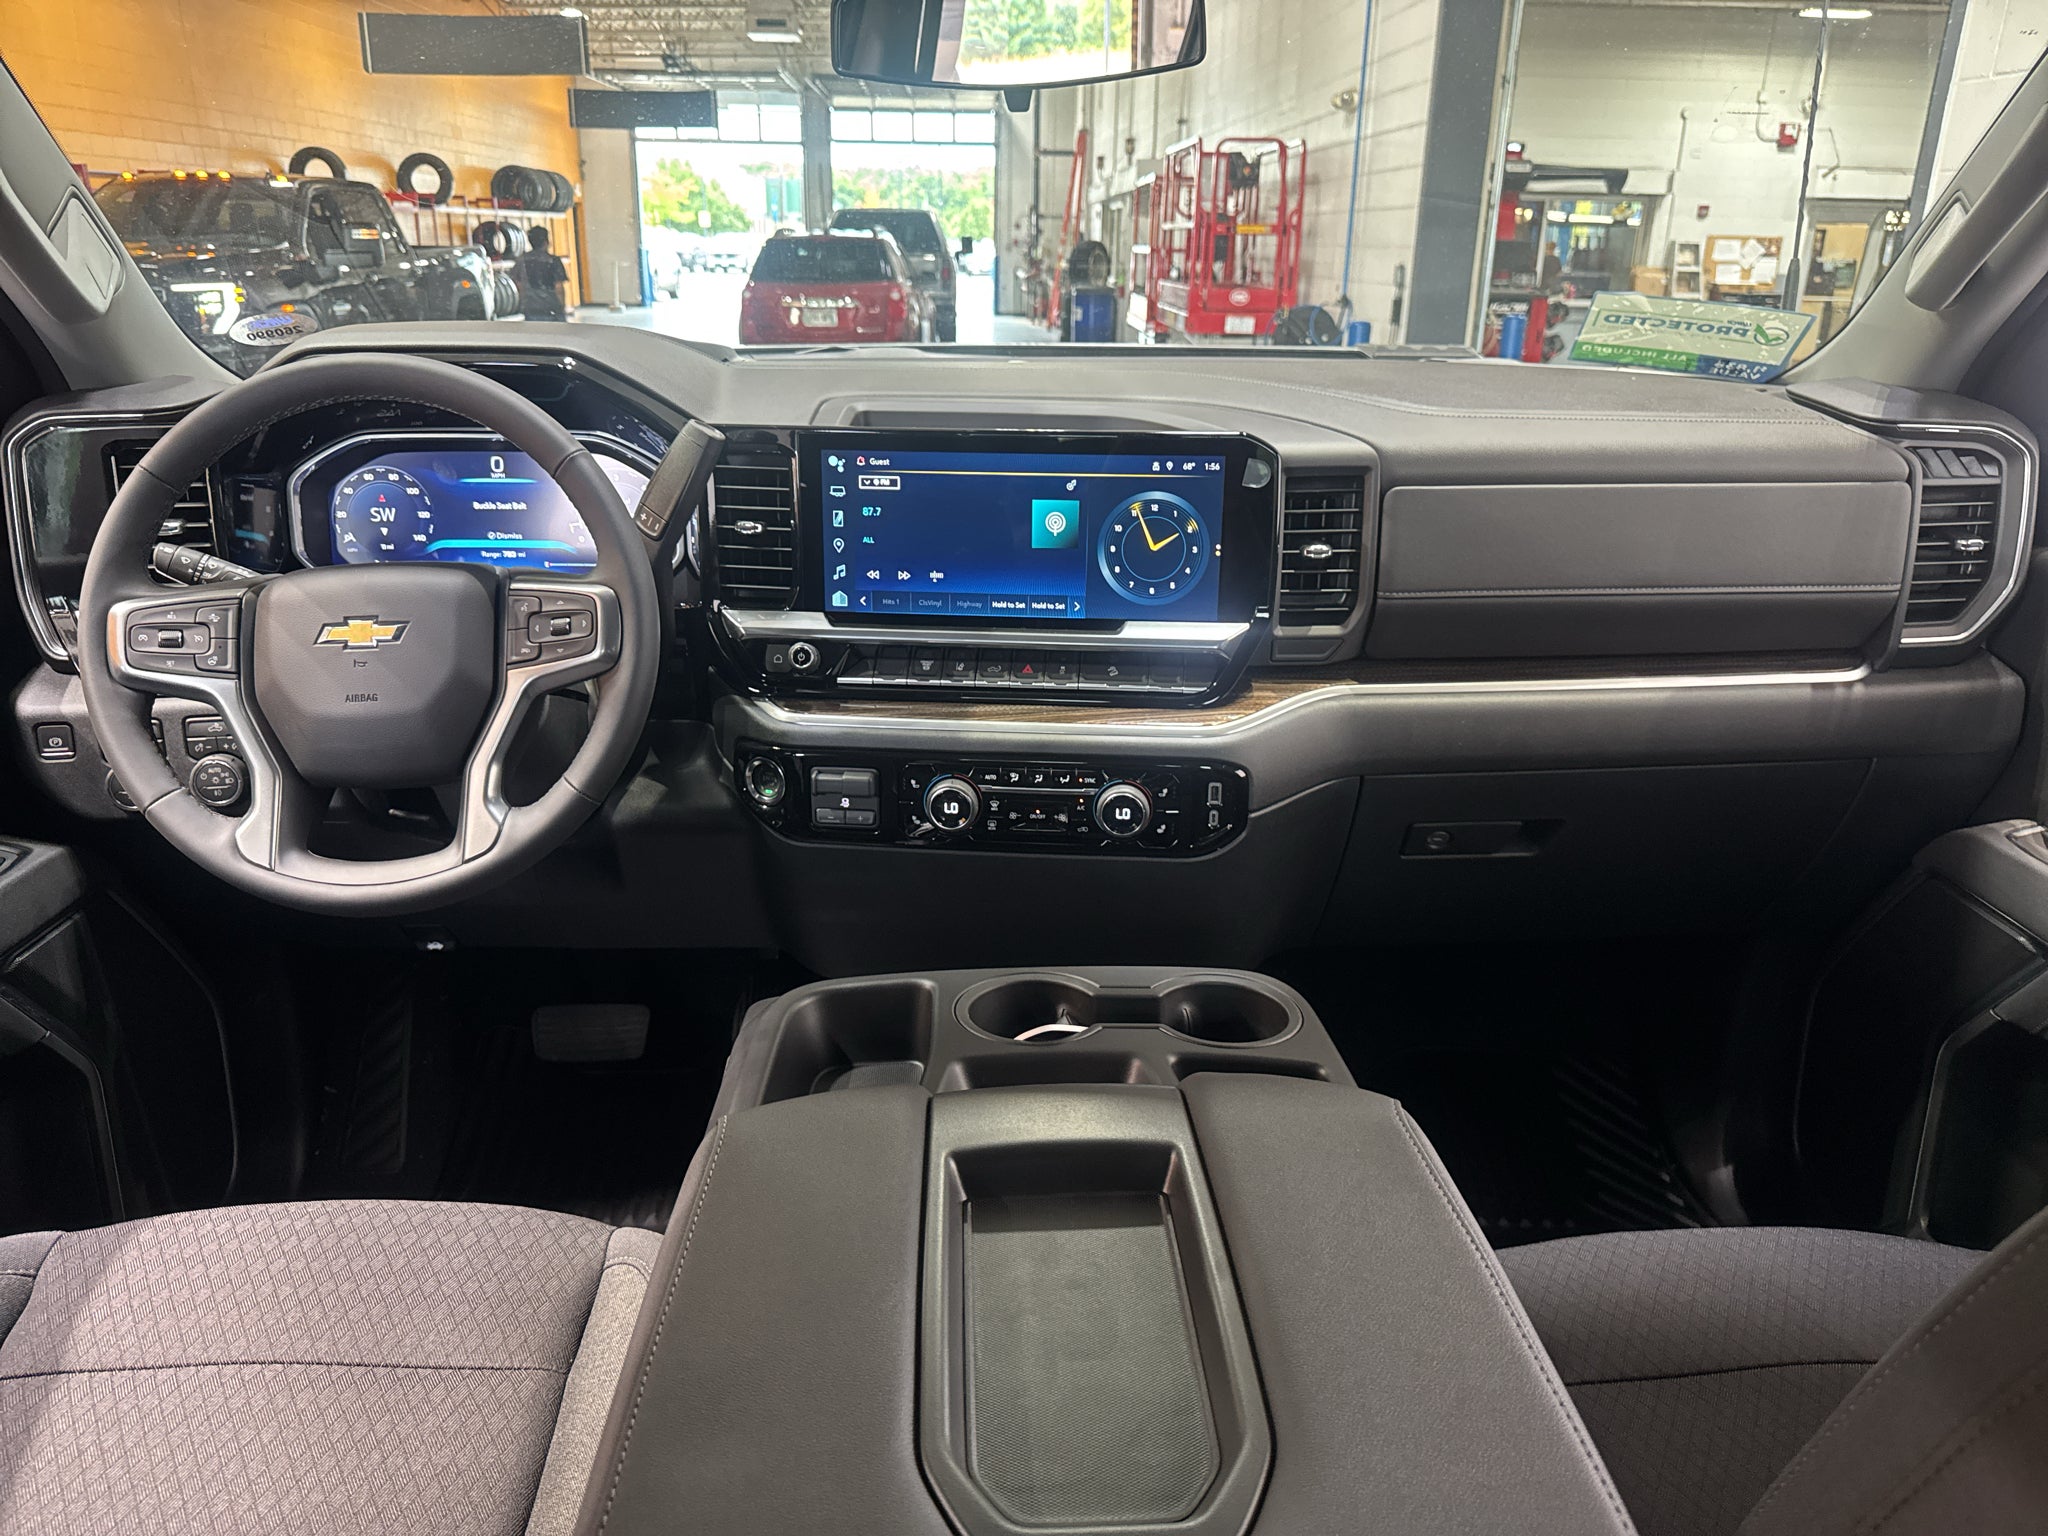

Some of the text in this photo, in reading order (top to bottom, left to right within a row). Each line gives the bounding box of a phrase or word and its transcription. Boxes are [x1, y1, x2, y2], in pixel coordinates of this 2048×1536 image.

[490, 456, 504, 472] 0
[869, 457, 890, 466] Guest
[1204, 462, 1220, 471] 1:56
[343, 486, 354, 494] 40
[405, 487, 420, 495] 100
[473, 501, 528, 510] Buckle Seat Belt
[1150, 504, 1159, 512] 12
[370, 507, 396, 522] SW
[417, 511, 431, 519] 120
[862, 506, 882, 516] 87.7
[1114, 524, 1123, 533] 10
[412, 534, 427, 542] 140
[496, 532, 523, 540] Dismiss
[863, 536, 875, 544] ALL
[1192, 545, 1198, 554] 3
[481, 550, 502, 559] Range:
[882, 597, 895, 605] Hits
[956, 600, 982, 609] Highway
[992, 601, 1007, 609] Hold
[1031, 602, 1046, 610] Hold
[344, 693, 378, 703] AIRBAG
[1115, 807, 1131, 821] LO
